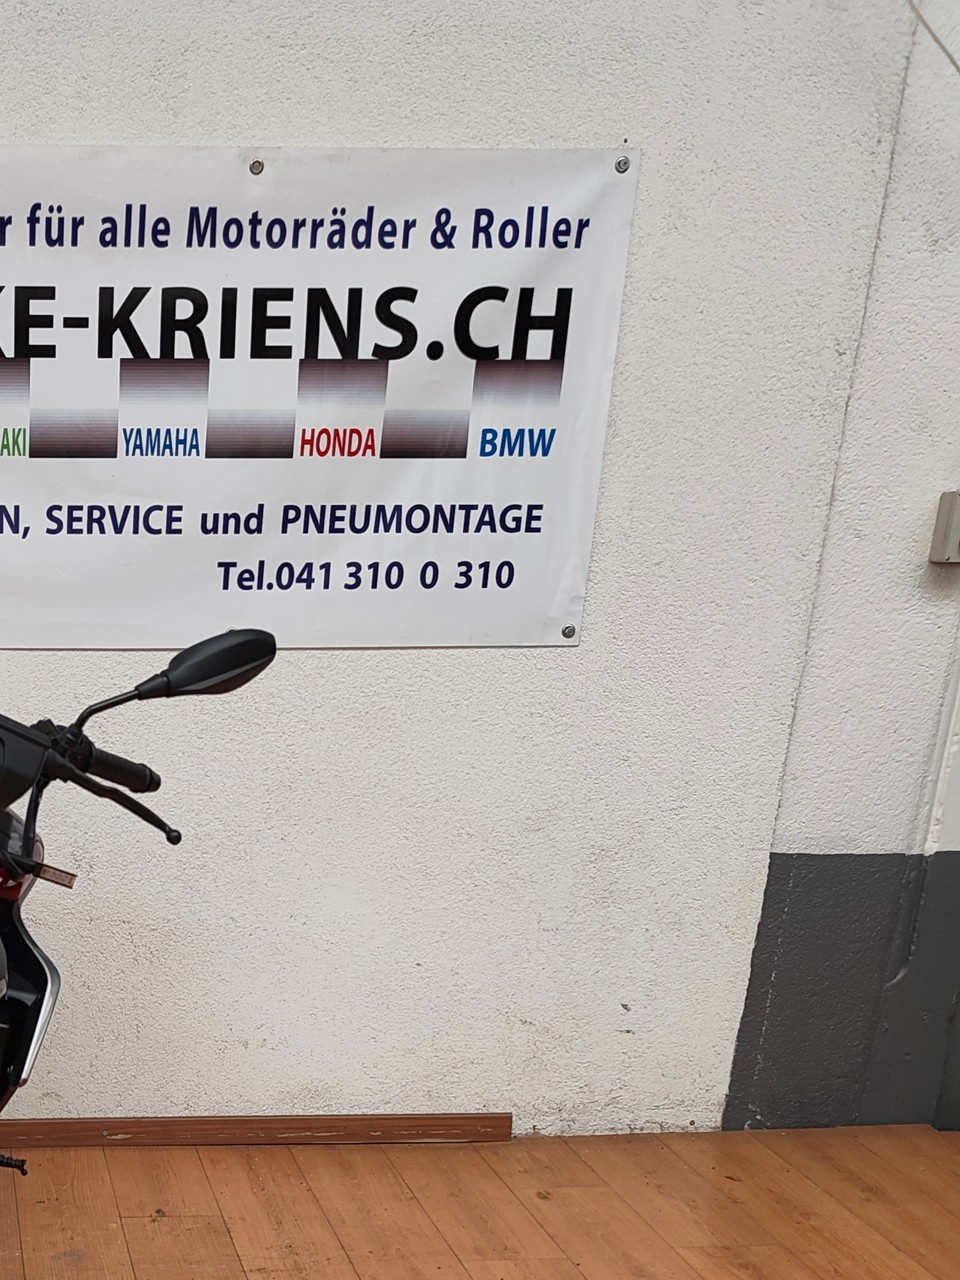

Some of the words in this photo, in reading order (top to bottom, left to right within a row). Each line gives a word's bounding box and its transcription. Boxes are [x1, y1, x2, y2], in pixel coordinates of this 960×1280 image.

[26, 202, 85, 248] für
[98, 203, 171, 249] alle
[185, 205, 417, 250] Motorräder
[429, 207, 458, 250] &
[471, 205, 591, 250] Roller
[122, 427, 201, 458] YAMAHA
[299, 427, 376, 458] HONDA
[478, 427, 557, 458] BMW
[45, 504, 184, 536] SERVICE
[200, 503, 265, 536] und
[280, 503, 544, 535] PNEUMONTAGE
[216, 559, 332, 592] Tel.041
[343, 560, 405, 591] 310
[419, 560, 440, 590] 0
[453, 560, 515, 590] 310
